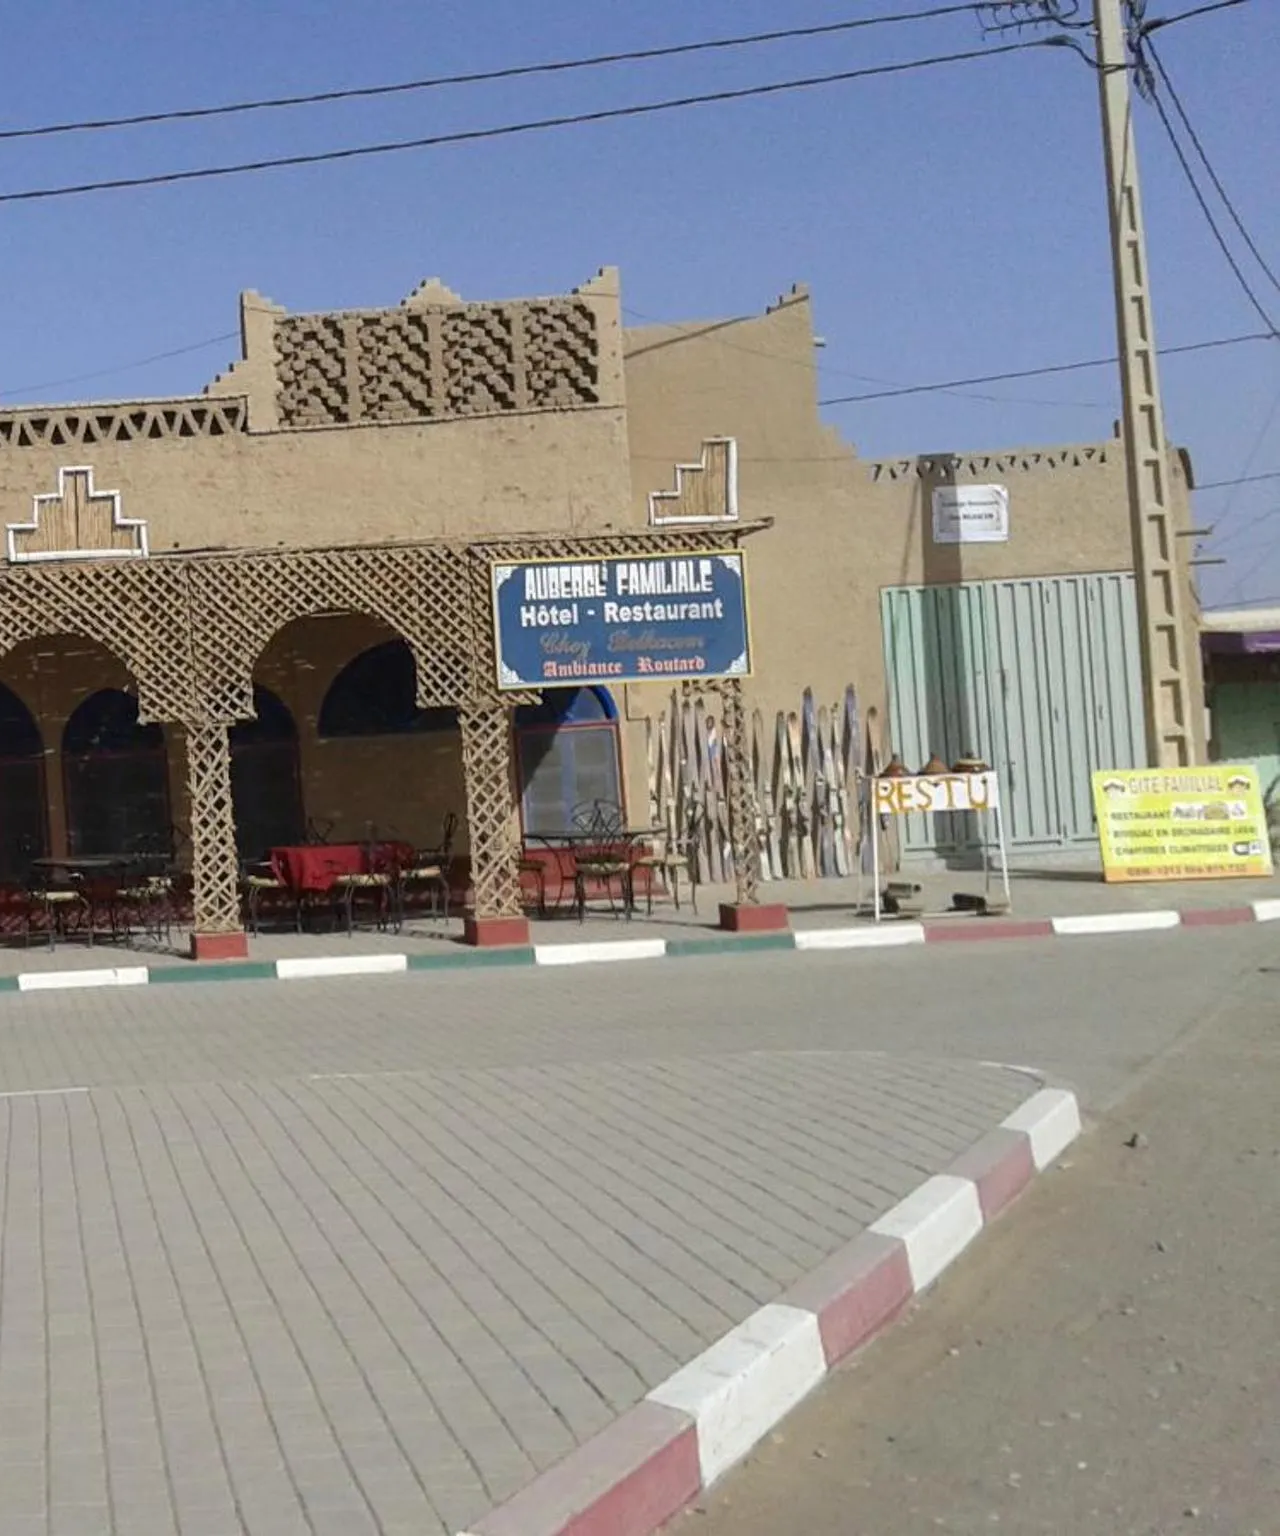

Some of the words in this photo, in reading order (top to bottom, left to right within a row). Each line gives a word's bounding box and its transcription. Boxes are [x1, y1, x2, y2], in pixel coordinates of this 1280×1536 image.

[525, 563, 607, 600] AUBERGE
[616, 559, 713, 595] FAMILIALE
[521, 603, 579, 627] Hôtel
[604, 598, 723, 623] Restaurant
[543, 659, 623, 678] Ambiance
[637, 655, 706, 673] Routard
[875, 775, 989, 816] RESTU
